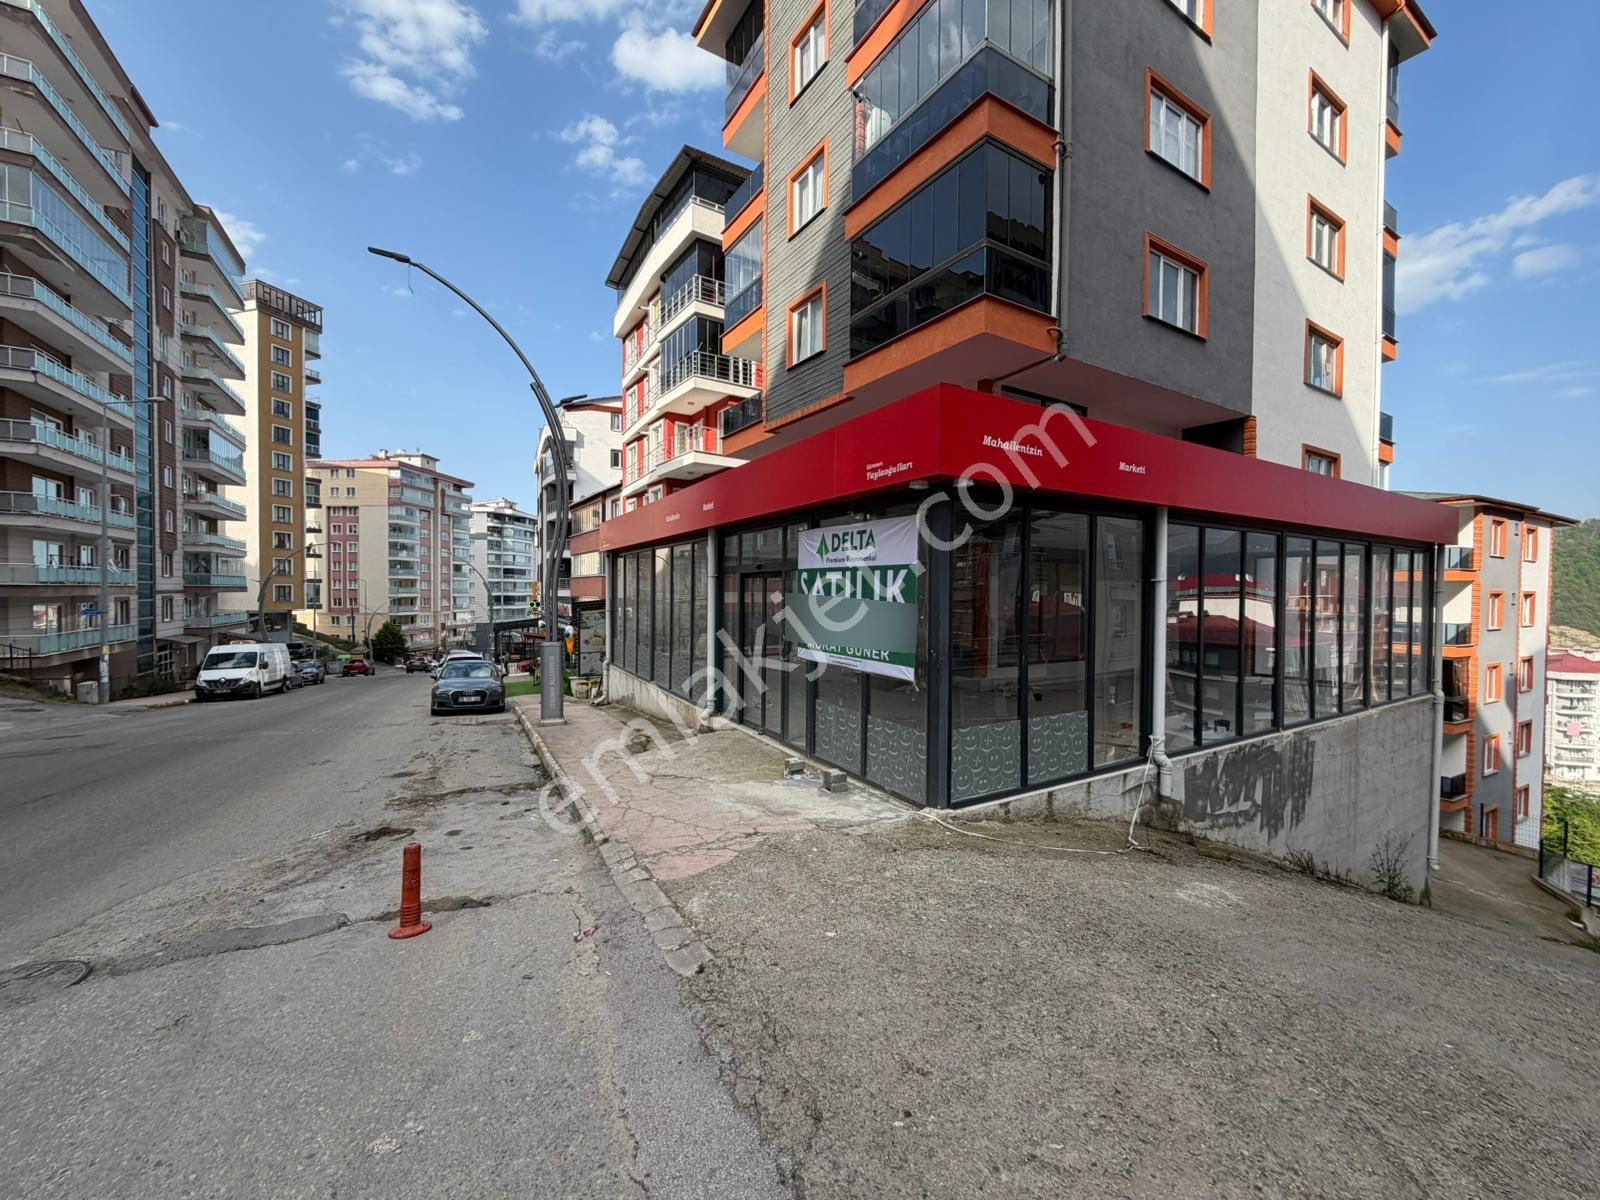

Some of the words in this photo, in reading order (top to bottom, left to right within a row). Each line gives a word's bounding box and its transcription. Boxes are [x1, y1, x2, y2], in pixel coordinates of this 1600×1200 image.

[1118, 461, 1146, 475] Marketi
[831, 528, 876, 552] DELTA
[800, 569, 908, 604] SATILIK
